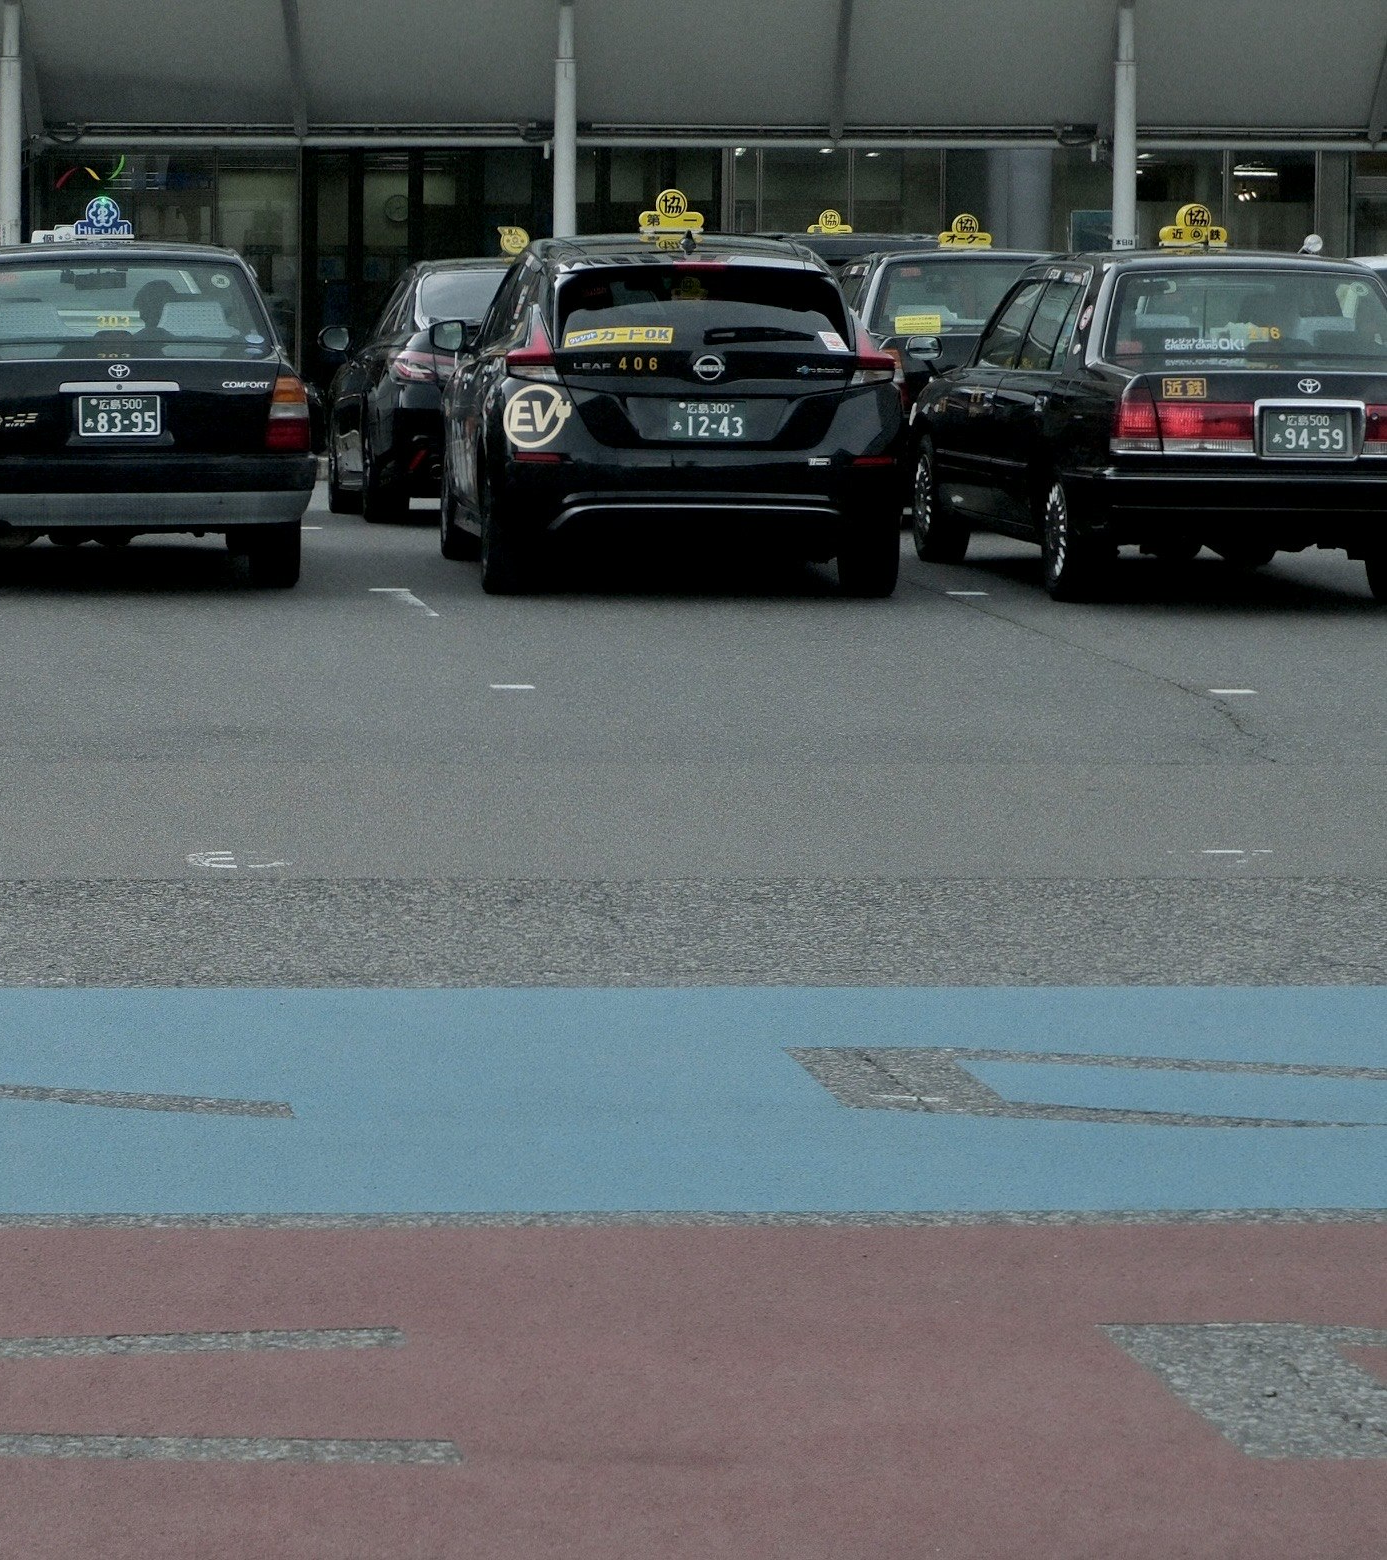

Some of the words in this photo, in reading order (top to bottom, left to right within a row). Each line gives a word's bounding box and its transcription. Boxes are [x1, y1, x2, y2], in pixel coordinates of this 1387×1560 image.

[662, 195, 682, 214] 協
[647, 213, 697, 227] 第一
[77, 224, 128, 235] HIFUMI
[946, 234, 987, 244] オーケー
[96, 315, 131, 328] 303
[573, 362, 611, 370] LEAF
[618, 357, 658, 371] 406
[693, 364, 725, 372] NISSAN
[222, 381, 270, 389] COMFORT
[1166, 380, 1203, 396] 近鉄
[98, 399, 143, 410] 広島500
[686, 403, 731, 414] 広島300
[97, 411, 156, 433] 83-95
[509, 401, 558, 433] EV
[1286, 415, 1330, 426] 広島500
[688, 416, 744, 437] 12-43
[1284, 428, 1344, 449] 94-59
